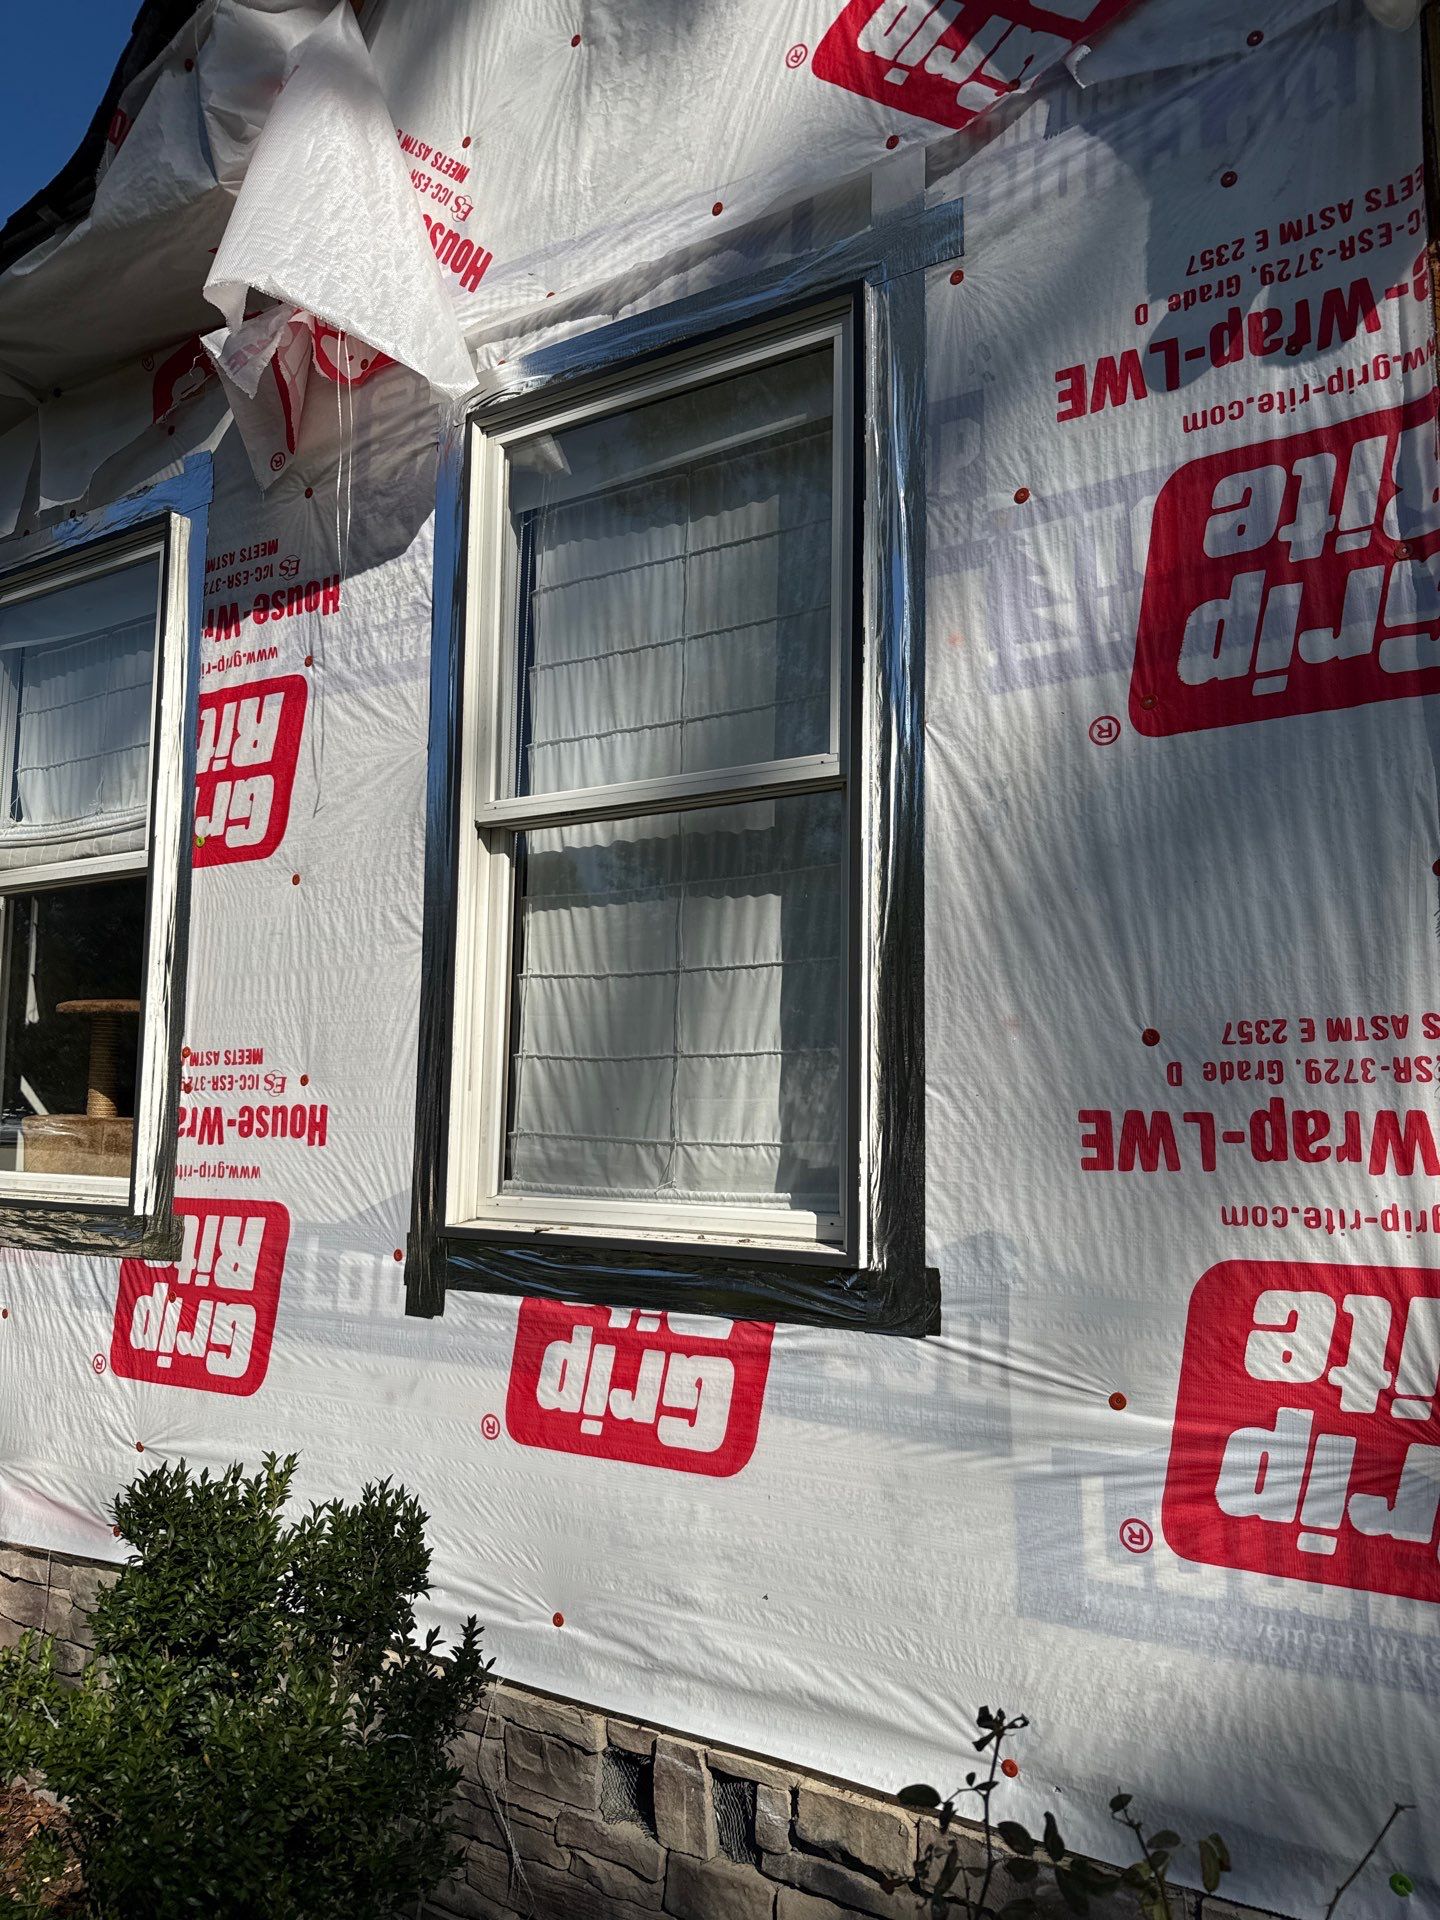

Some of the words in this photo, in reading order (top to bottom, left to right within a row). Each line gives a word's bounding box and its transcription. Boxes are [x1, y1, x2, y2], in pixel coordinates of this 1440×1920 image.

[401, 134, 432, 161] ASTM
[431, 152, 470, 183] MEETS
[1281, 198, 1354, 245] ASTM
[423, 211, 492, 292] Hous
[1257, 231, 1269, 252] E
[1186, 238, 1244, 276] 2357
[1167, 275, 1241, 312] Grade
[1135, 304, 1149, 325] D
[207, 551, 236, 573] ASTM
[240, 538, 279, 562] MEETS
[1221, 1018, 1288, 1045] 2357
[1299, 1017, 1316, 1043] E
[1326, 1013, 1409, 1043] ASTM
[189, 1050, 220, 1067] ASTM
[224, 1048, 264, 1066] MEETS
[1166, 1061, 1183, 1087] D
[1202, 1059, 1285, 1086] Grade
[130, 1282, 257, 1378] Grip
[536, 1324, 735, 1453] Grip
